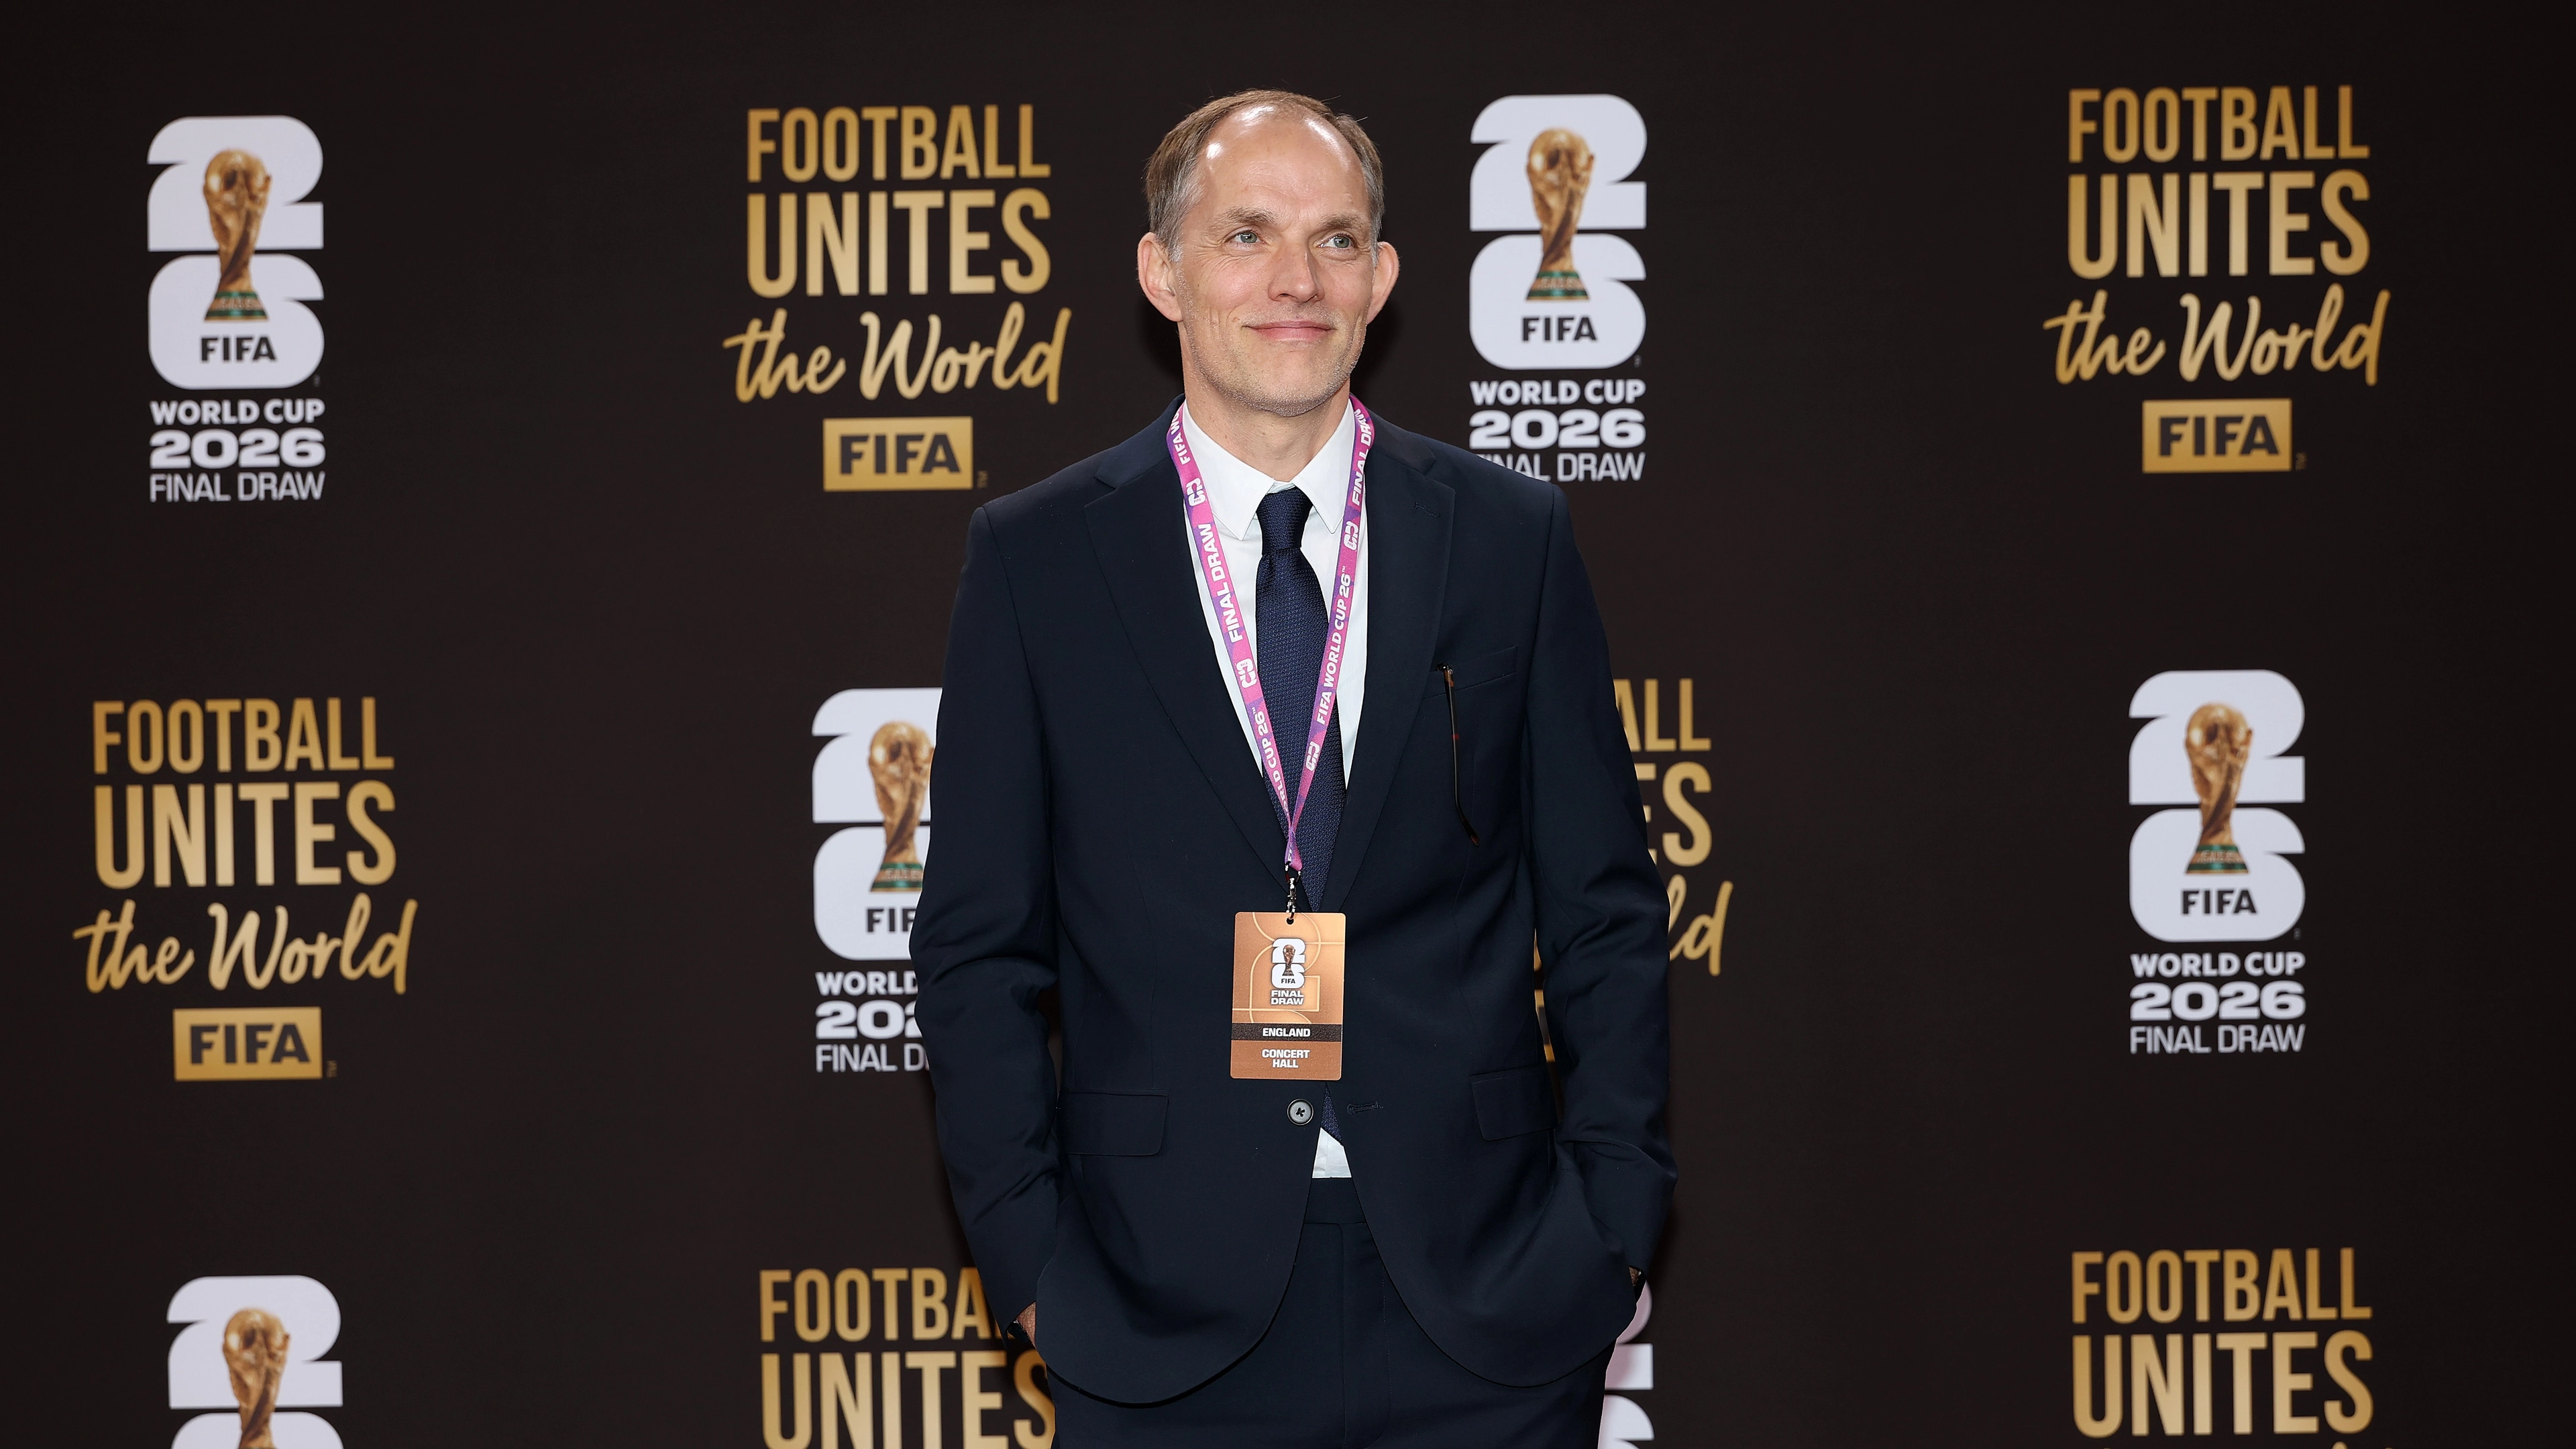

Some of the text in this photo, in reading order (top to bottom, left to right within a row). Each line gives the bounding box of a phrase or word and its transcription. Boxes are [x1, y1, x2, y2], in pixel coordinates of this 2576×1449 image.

[747, 105, 1051, 182] FOOTBALL
[2069, 86, 2370, 163] FOOTBALL
[747, 188, 1051, 299] UNITES
[2068, 170, 2370, 280] UNITES
[1521, 316, 1597, 342] FIFA
[2043, 284, 2391, 386] the World
[201, 336, 277, 363] FIFA
[723, 301, 1072, 405] the World
[150, 398, 325, 425] WORLD CUP
[1470, 379, 1646, 406] WORLD CUP
[150, 427, 326, 470] 2026
[1173, 432, 1191, 465] FIFA
[1469, 409, 1646, 449] 2026
[2159, 415, 2280, 458] FIFA
[840, 433, 961, 475] FIFA
[1557, 452, 1646, 482] DRAW
[150, 472, 326, 502] FINAL DRAW
[1352, 448, 1368, 506] FINAL
[1198, 523, 1243, 643] FINAL DRAW
[1334, 598, 1347, 631] CUP
[1324, 632, 1342, 688] WORLD
[1317, 692, 1332, 725] FIFA
[93, 697, 395, 775] FOOTBALL
[1262, 738, 1277, 769] CUP
[95, 780, 396, 890] UNITES
[866, 907, 917, 933] FIF
[2182, 889, 2257, 916] FIFA
[72, 893, 419, 995] the World
[816, 971, 918, 996] WORLD
[2130, 952, 2306, 978] WORLD CUP
[1271, 989, 1304, 998] FINAL
[2130, 981, 2306, 1021] 2026
[190, 1023, 311, 1065] FIFA
[1263, 1028, 1311, 1037] ENGLAND
[2130, 1024, 2306, 1055] FINAL DRAW
[816, 1044, 898, 1073] FINAL
[1262, 1049, 1310, 1059] CONCERT
[1272, 1059, 1299, 1068] HALL
[759, 1267, 1004, 1342] FOOTBA
[2072, 1248, 2373, 1324] FOOTBALL
[761, 1350, 1055, 1449] UNITES
[2072, 1330, 2374, 1439] UNITES
